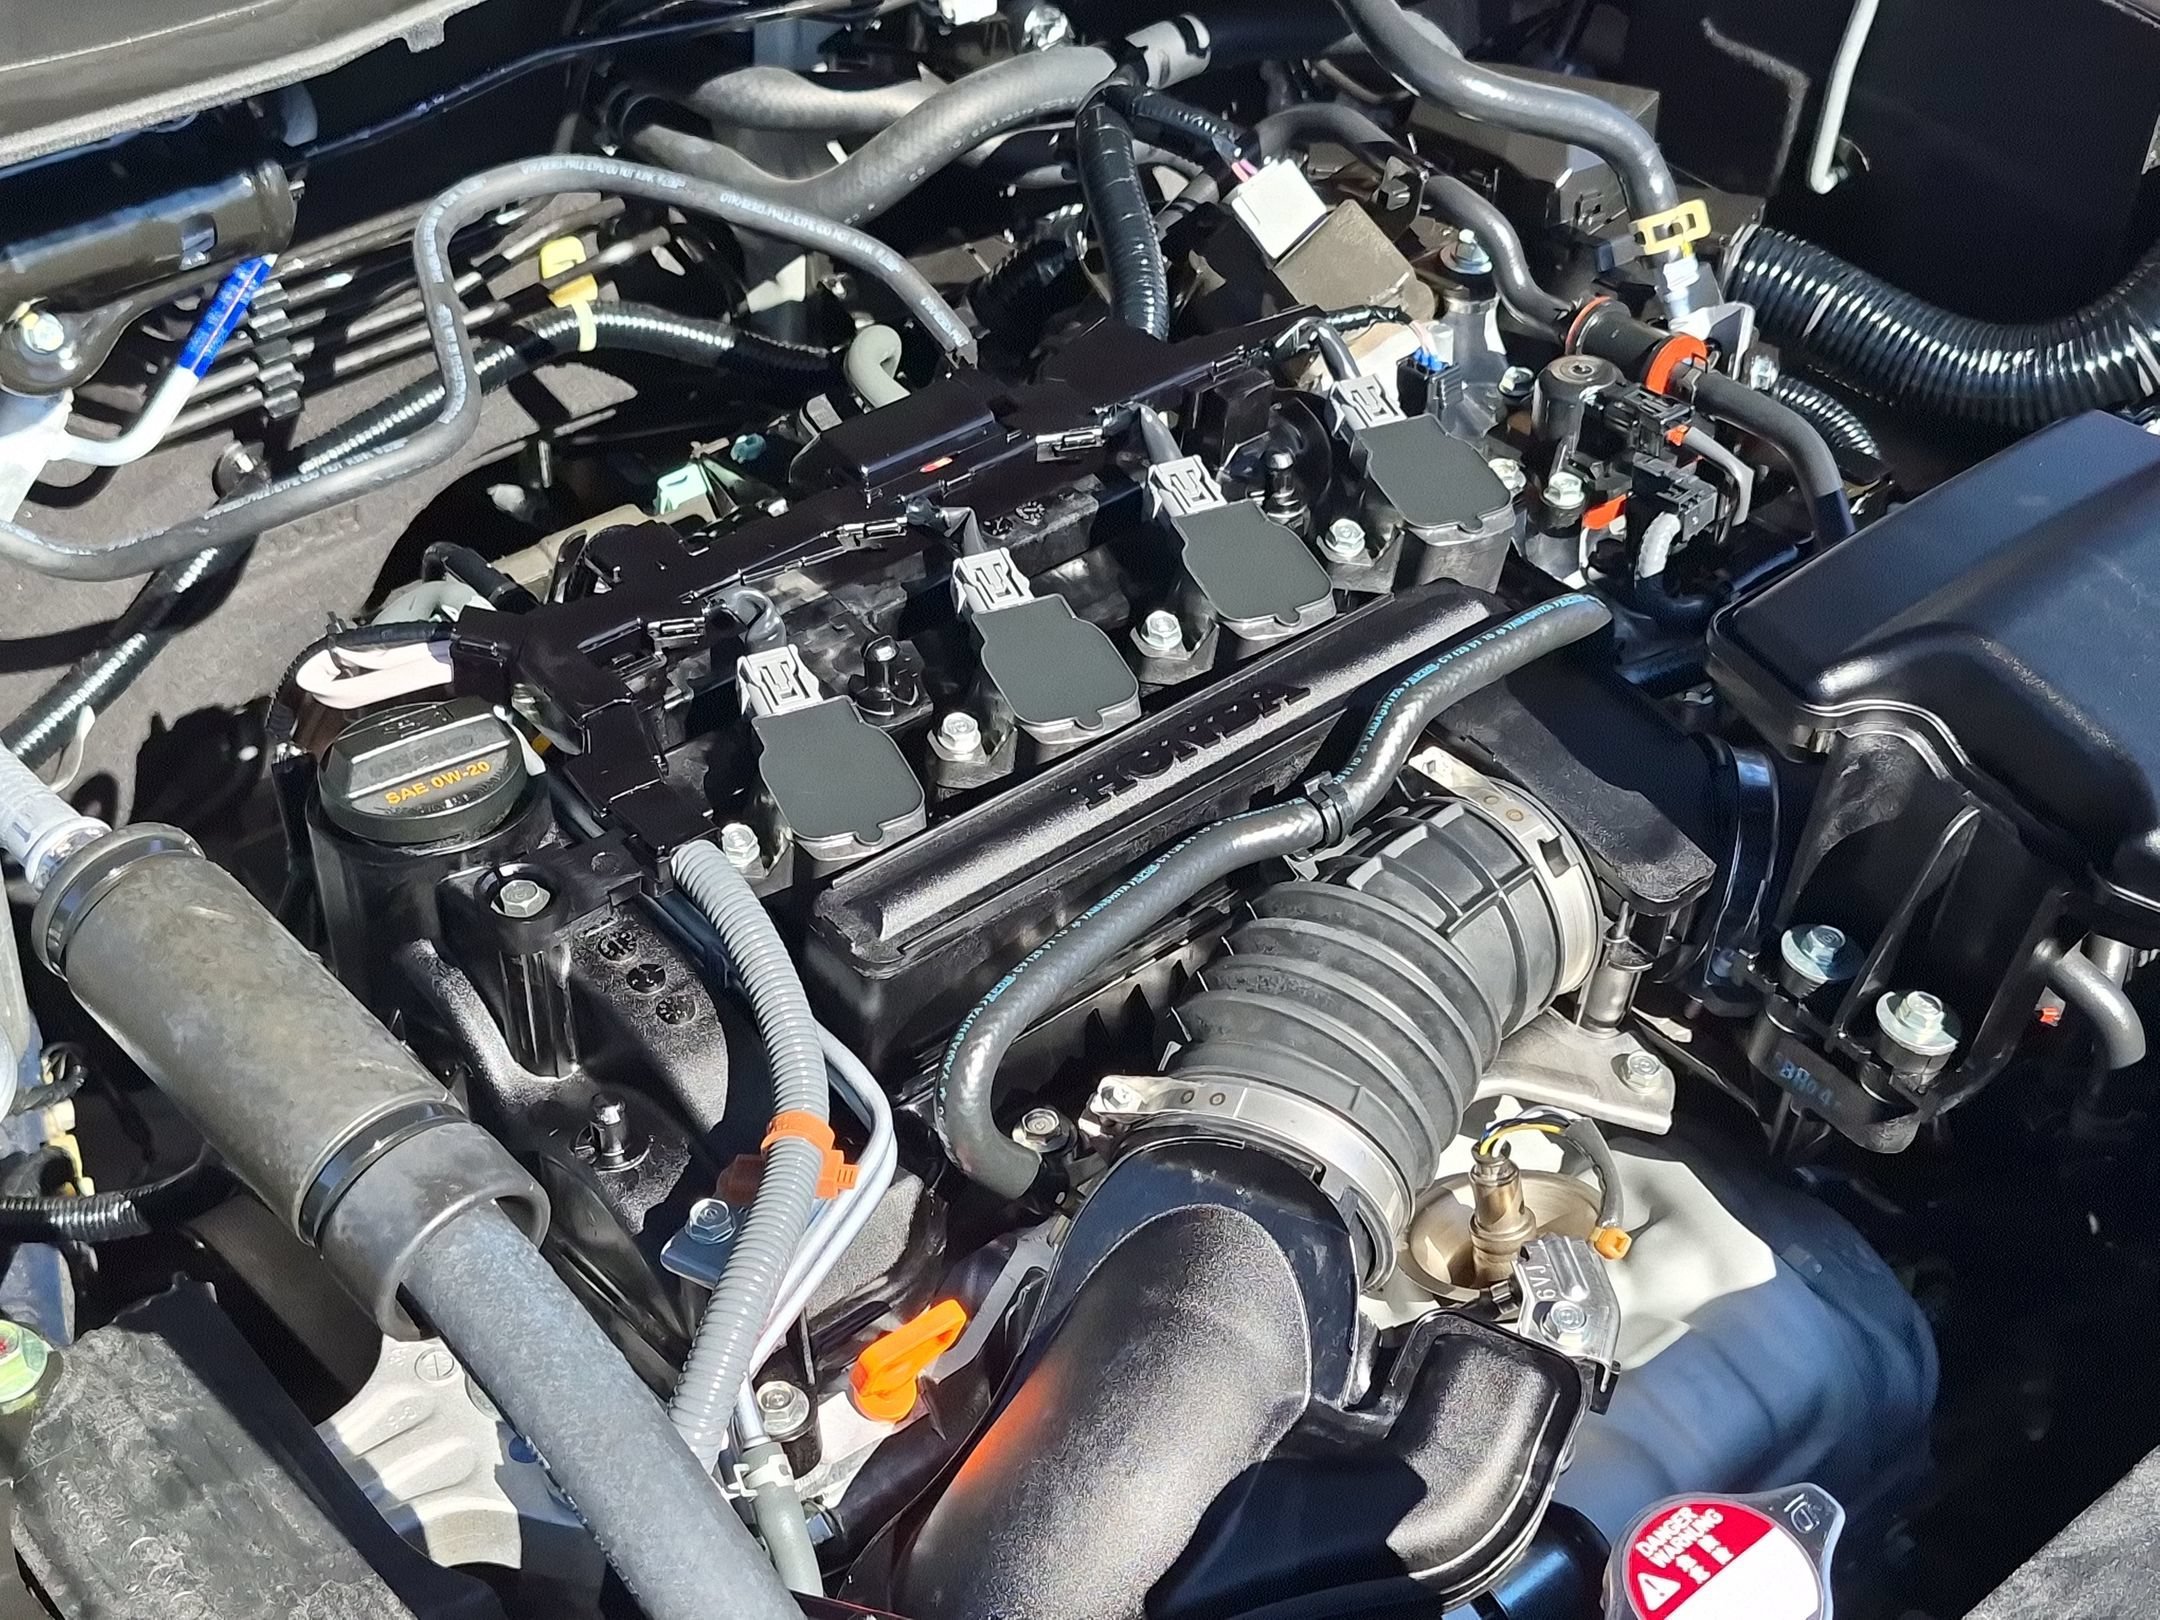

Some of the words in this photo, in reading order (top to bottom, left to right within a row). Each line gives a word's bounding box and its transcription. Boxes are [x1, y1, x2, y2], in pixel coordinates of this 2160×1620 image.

[1364, 687, 1405, 742] YAMASHITA
[1070, 686, 1311, 811] HONDA
[385, 782, 428, 804] SAE
[431, 761, 490, 788] 0W-20
[940, 1005, 984, 1080] YAMASHITA
[1636, 1506, 1698, 1558] DANGER
